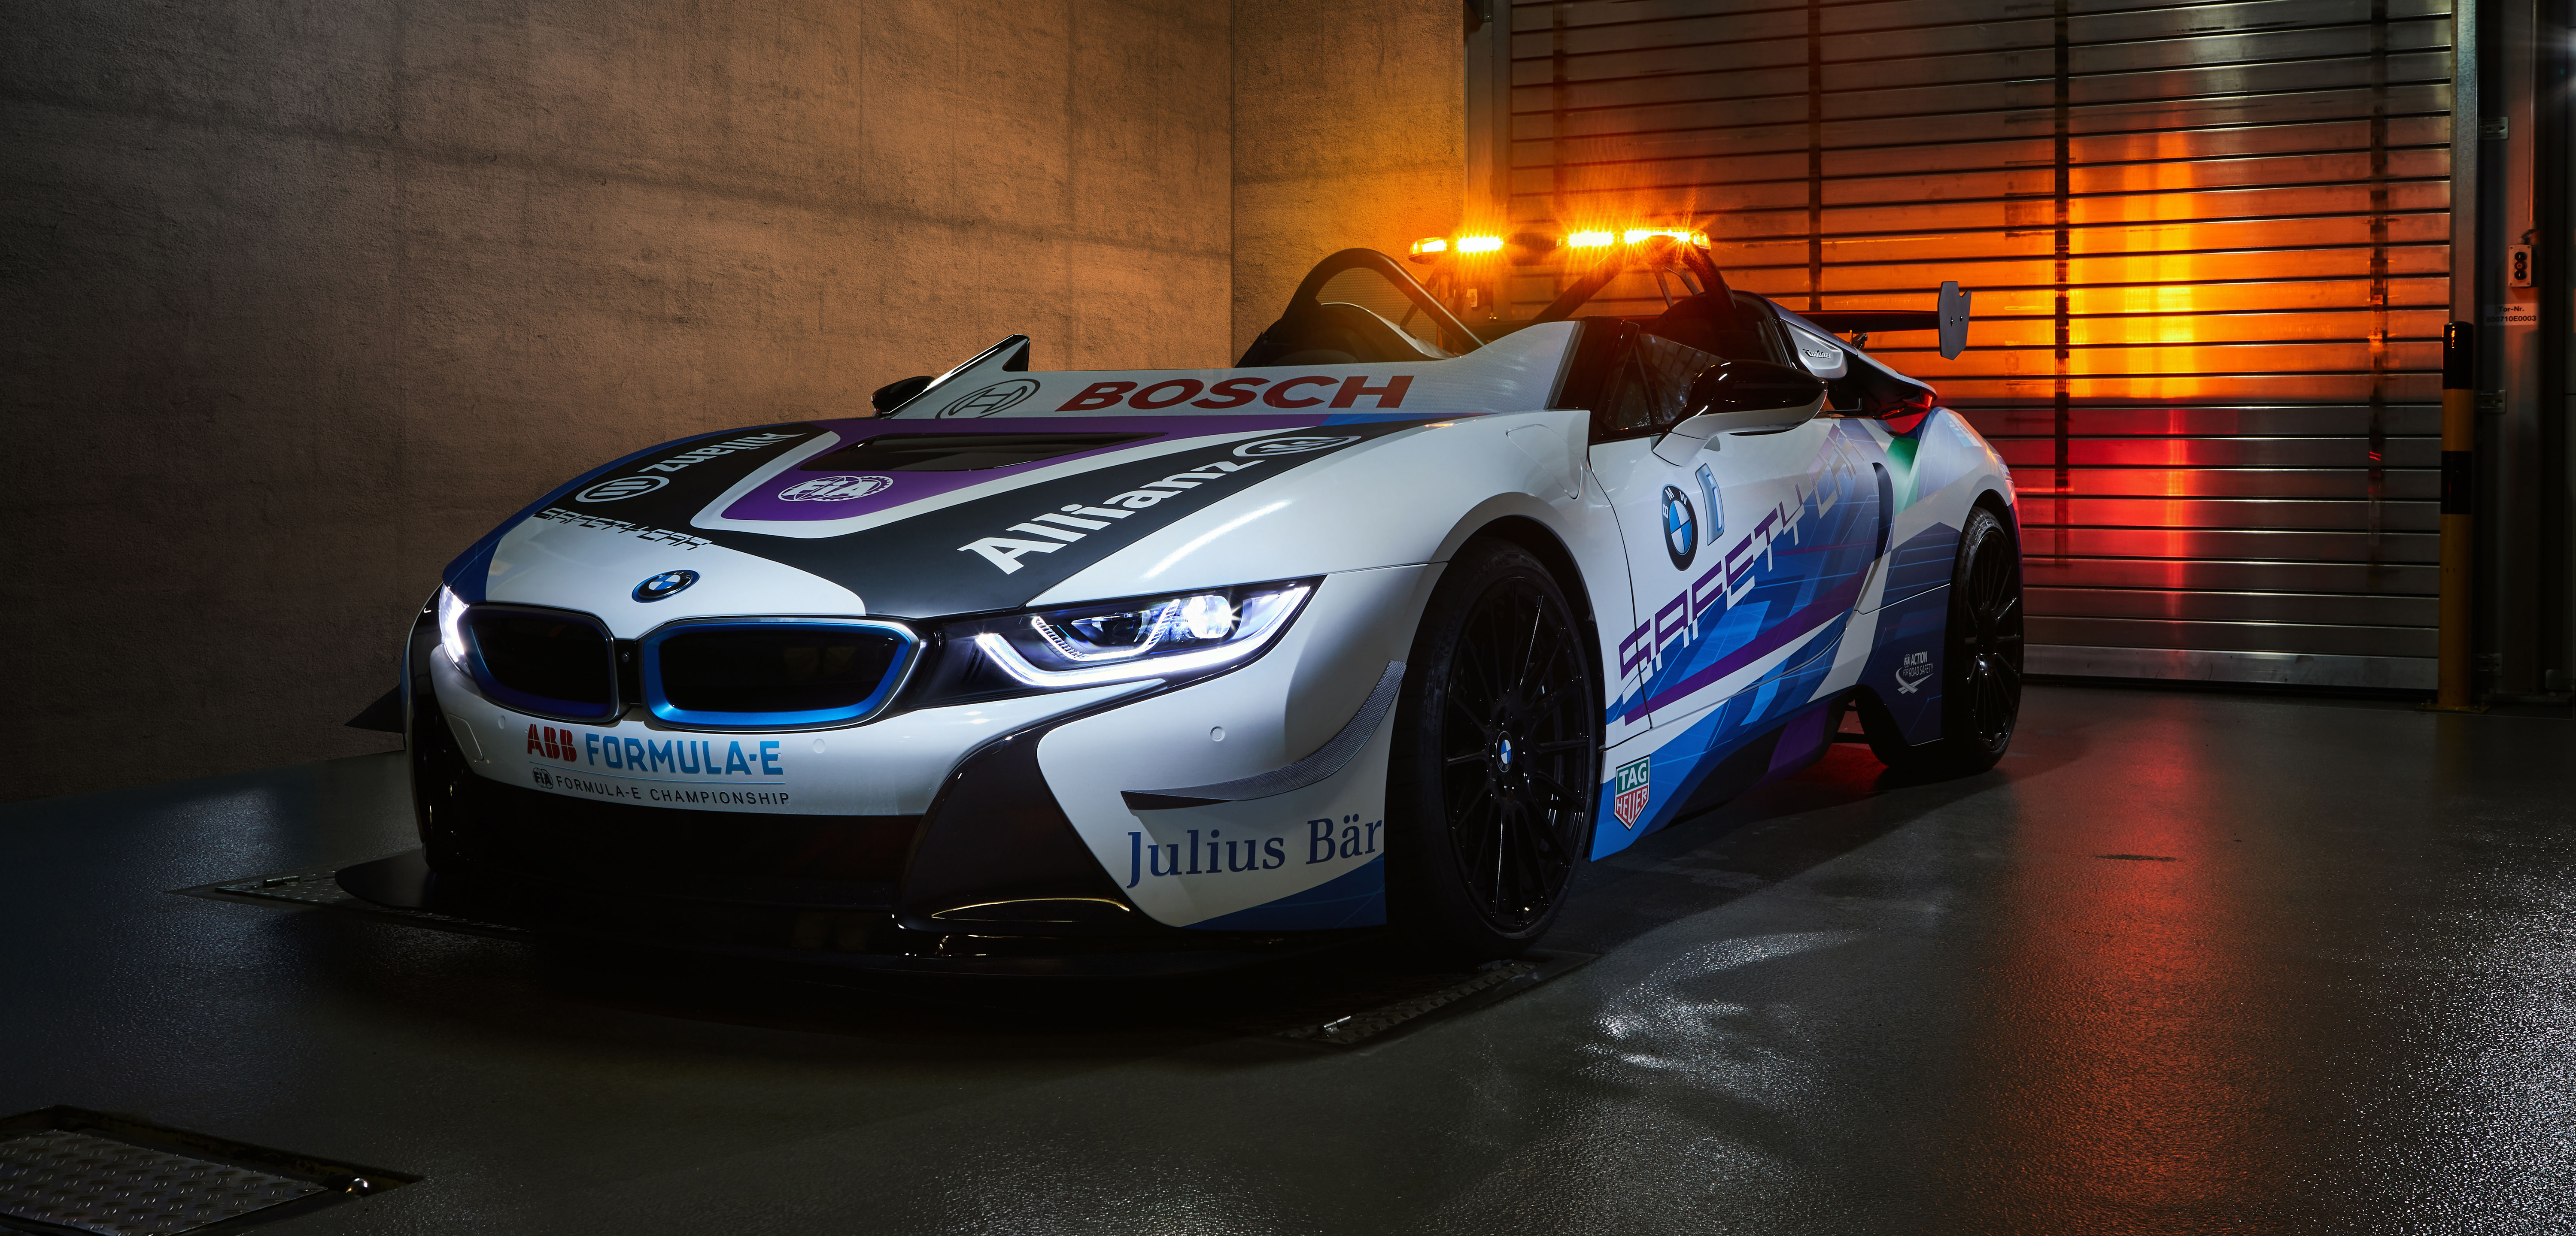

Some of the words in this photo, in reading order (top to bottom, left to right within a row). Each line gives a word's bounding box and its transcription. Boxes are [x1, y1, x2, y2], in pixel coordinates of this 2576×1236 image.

[1054, 375, 1415, 412] BOSCH
[637, 433, 807, 472] Allianz
[957, 459, 1266, 575] Allianz
[1662, 487, 1687, 519] BMW
[533, 507, 649, 534] SAFETY
[636, 528, 713, 551] CAR
[1619, 483, 1805, 705] SAFETY
[1909, 666, 1920, 678] ROAD
[1920, 663, 1934, 675] SAFETY
[1911, 651, 1928, 666] ACTION
[527, 724, 577, 763] ABB
[556, 775, 641, 800] FORMULA-E
[650, 788, 790, 805] CHAMPIONSHIP
[1619, 763, 1647, 791] TAG
[1616, 788, 1647, 824] HEUER
[1126, 829, 1286, 889] Julius
[1306, 813, 1382, 865] Bär
